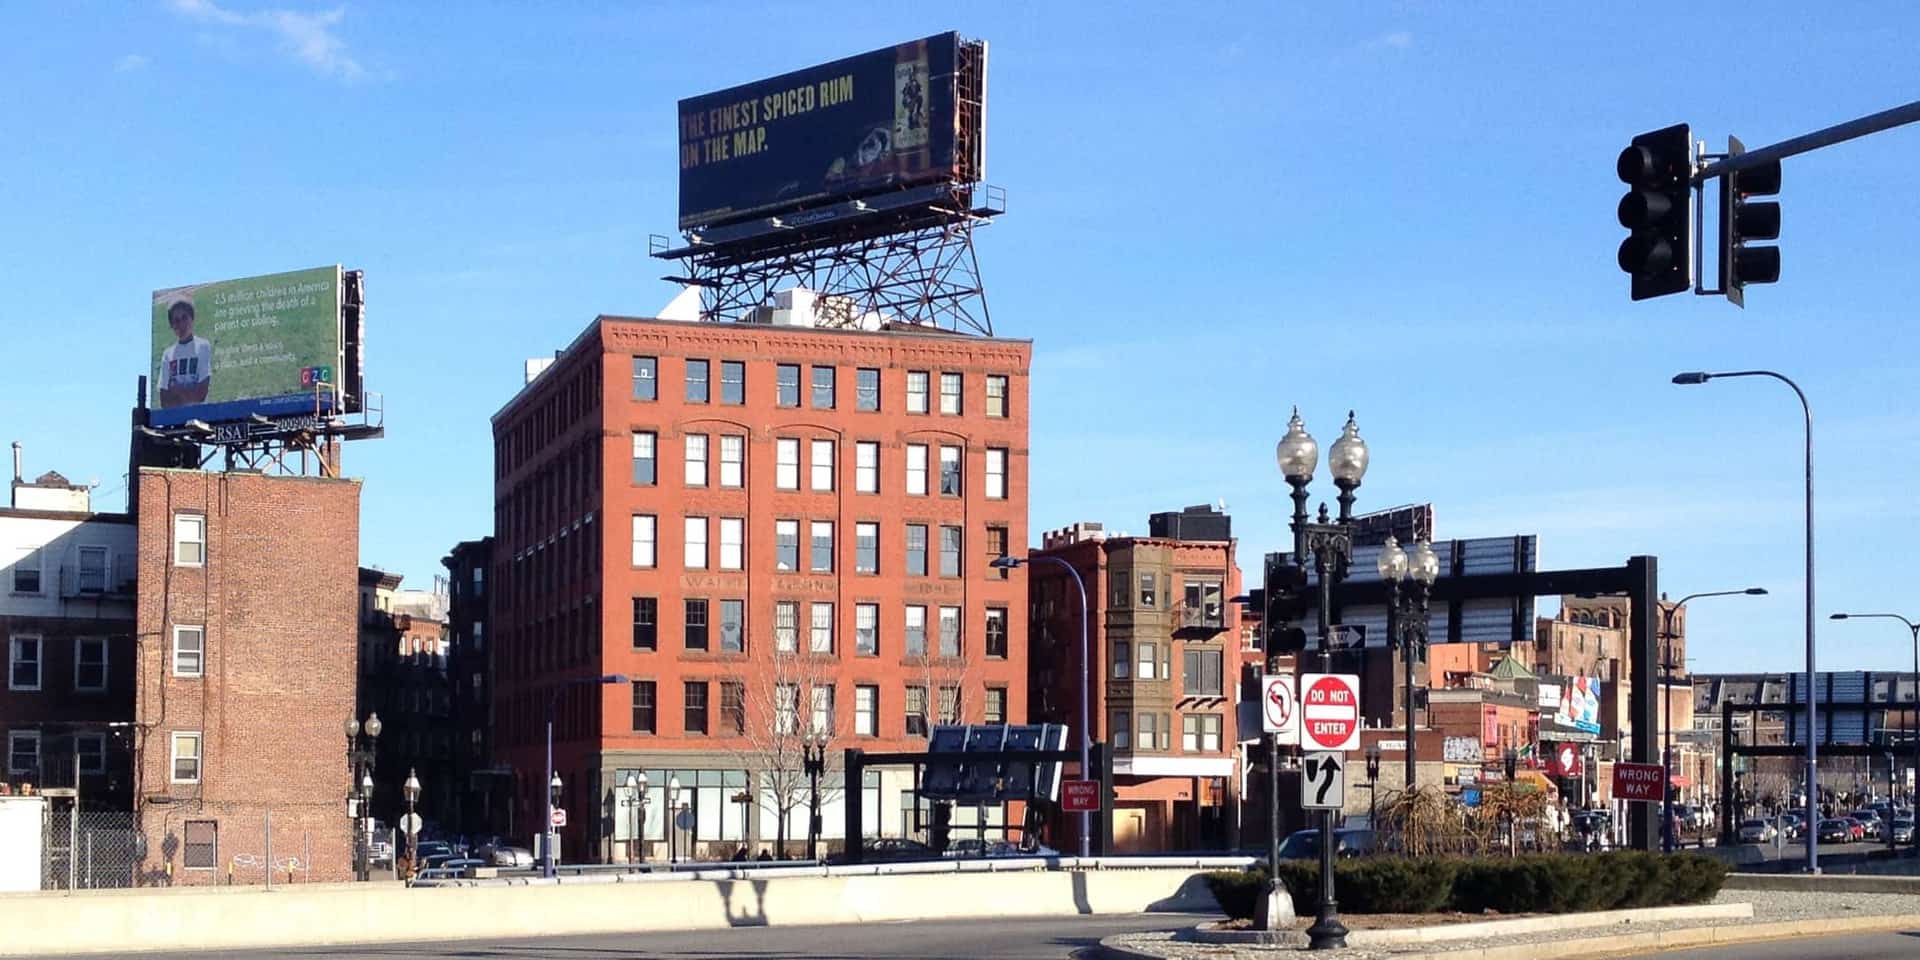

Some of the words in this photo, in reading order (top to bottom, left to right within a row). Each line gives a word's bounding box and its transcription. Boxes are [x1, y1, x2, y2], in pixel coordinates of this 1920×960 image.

[681, 111, 705, 141] THE
[709, 99, 759, 134] FINEST
[763, 84, 815, 122] SPICED
[819, 73, 854, 108] RUM
[681, 143, 700, 169] ON
[704, 135, 729, 164] THE
[733, 126, 769, 158] MAP.
[256, 284, 287, 299] children
[288, 284, 296, 295] in
[297, 280, 330, 294] America
[276, 296, 299, 309] death
[300, 295, 309, 306] of
[214, 317, 240, 333] parent
[240, 318, 251, 328] or
[217, 426, 241, 441] RSA
[1311, 689, 1324, 701] DO
[1330, 689, 1349, 701] NOT
[1314, 721, 1346, 734] ENTER
[1619, 768, 1659, 782] WRONG
[1068, 785, 1095, 795] WRONG
[1626, 783, 1650, 795] WAY
[1072, 797, 1088, 806] WAY
